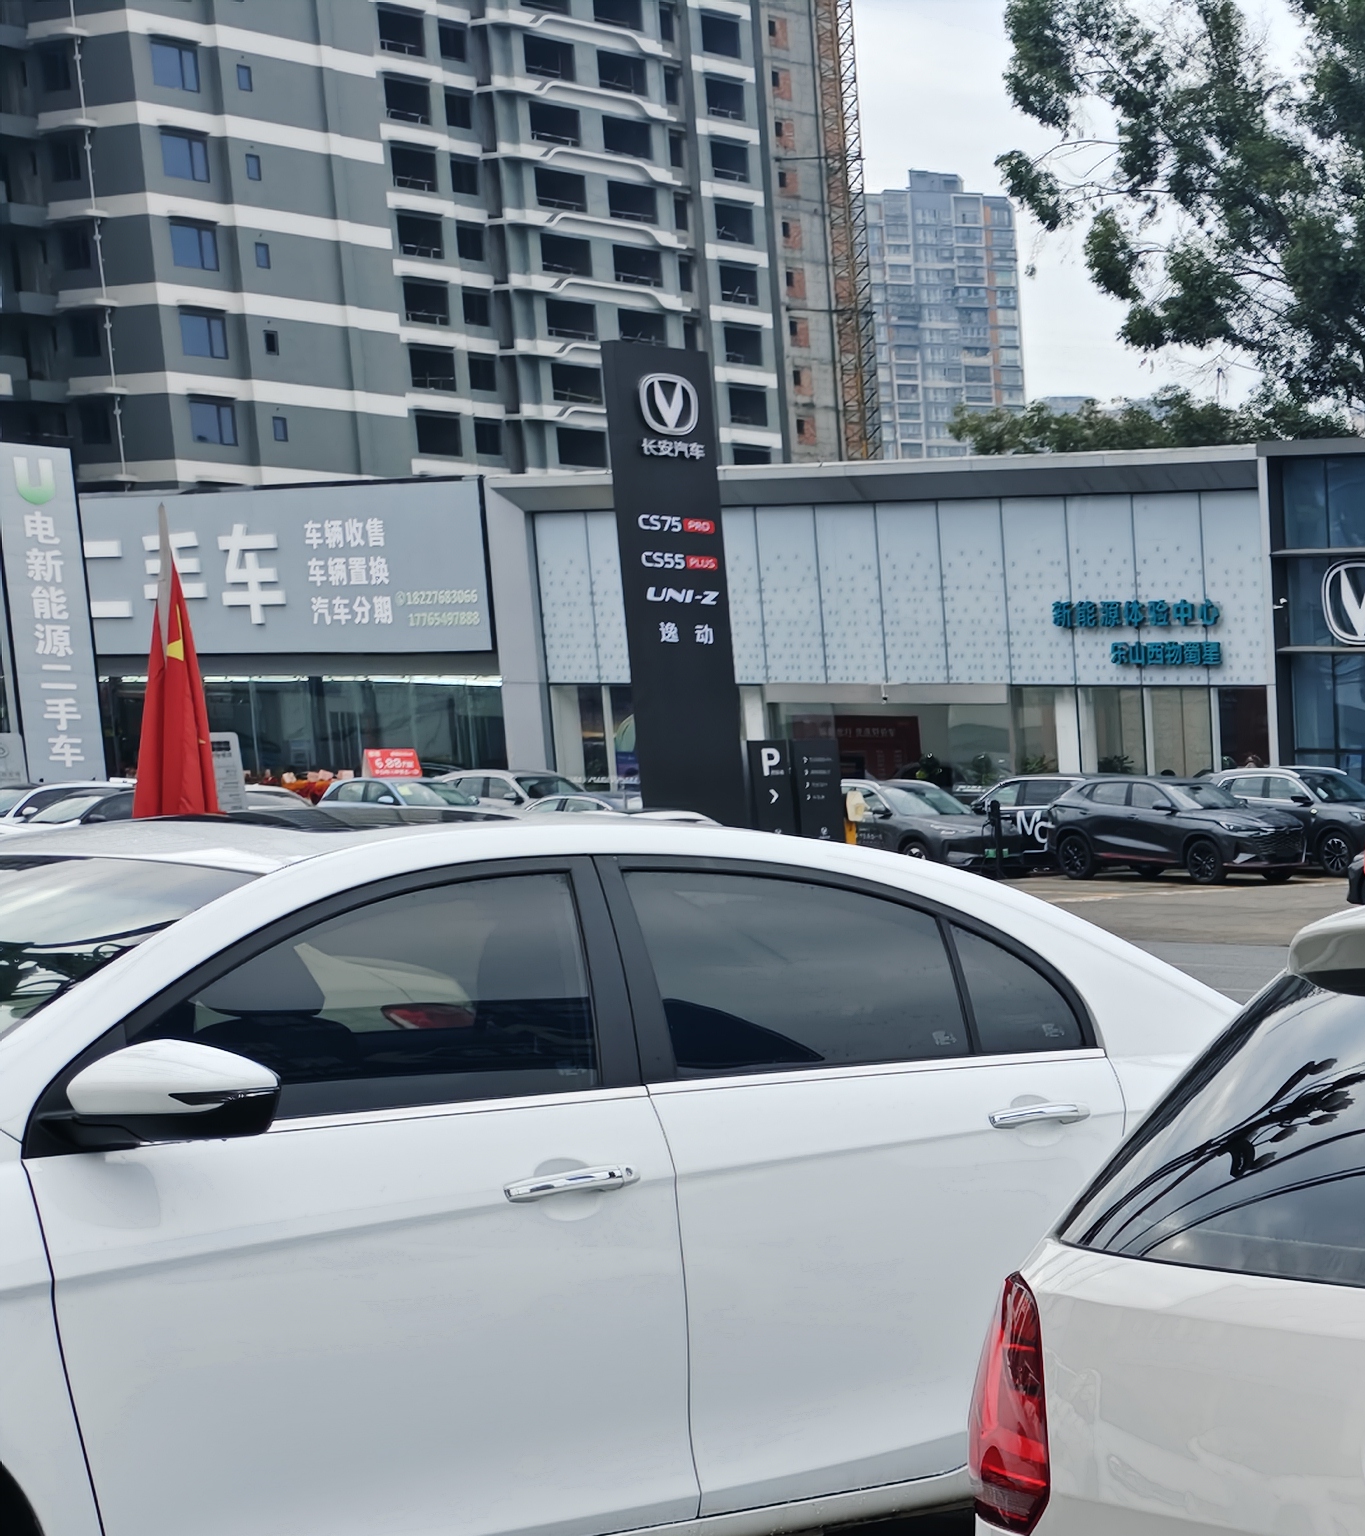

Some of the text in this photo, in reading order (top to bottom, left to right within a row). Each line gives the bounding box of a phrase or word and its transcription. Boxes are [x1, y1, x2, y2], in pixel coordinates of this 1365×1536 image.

[641, 438, 706, 460] 长安汽车
[304, 518, 385, 549] 车辆收售
[638, 514, 711, 532] CS75 PRO
[84, 524, 286, 625] 二手车
[307, 556, 389, 586] 车辆置换
[641, 552, 716, 570] CS55 PLUS
[646, 587, 720, 605] UNI-Z
[311, 596, 393, 625] 汽车分期
[1053, 599, 1220, 628] 新能源体验中心
[24, 511, 85, 768] 电新能源二手车
[659, 621, 715, 645] 逸动
[761, 748, 780, 776] P
